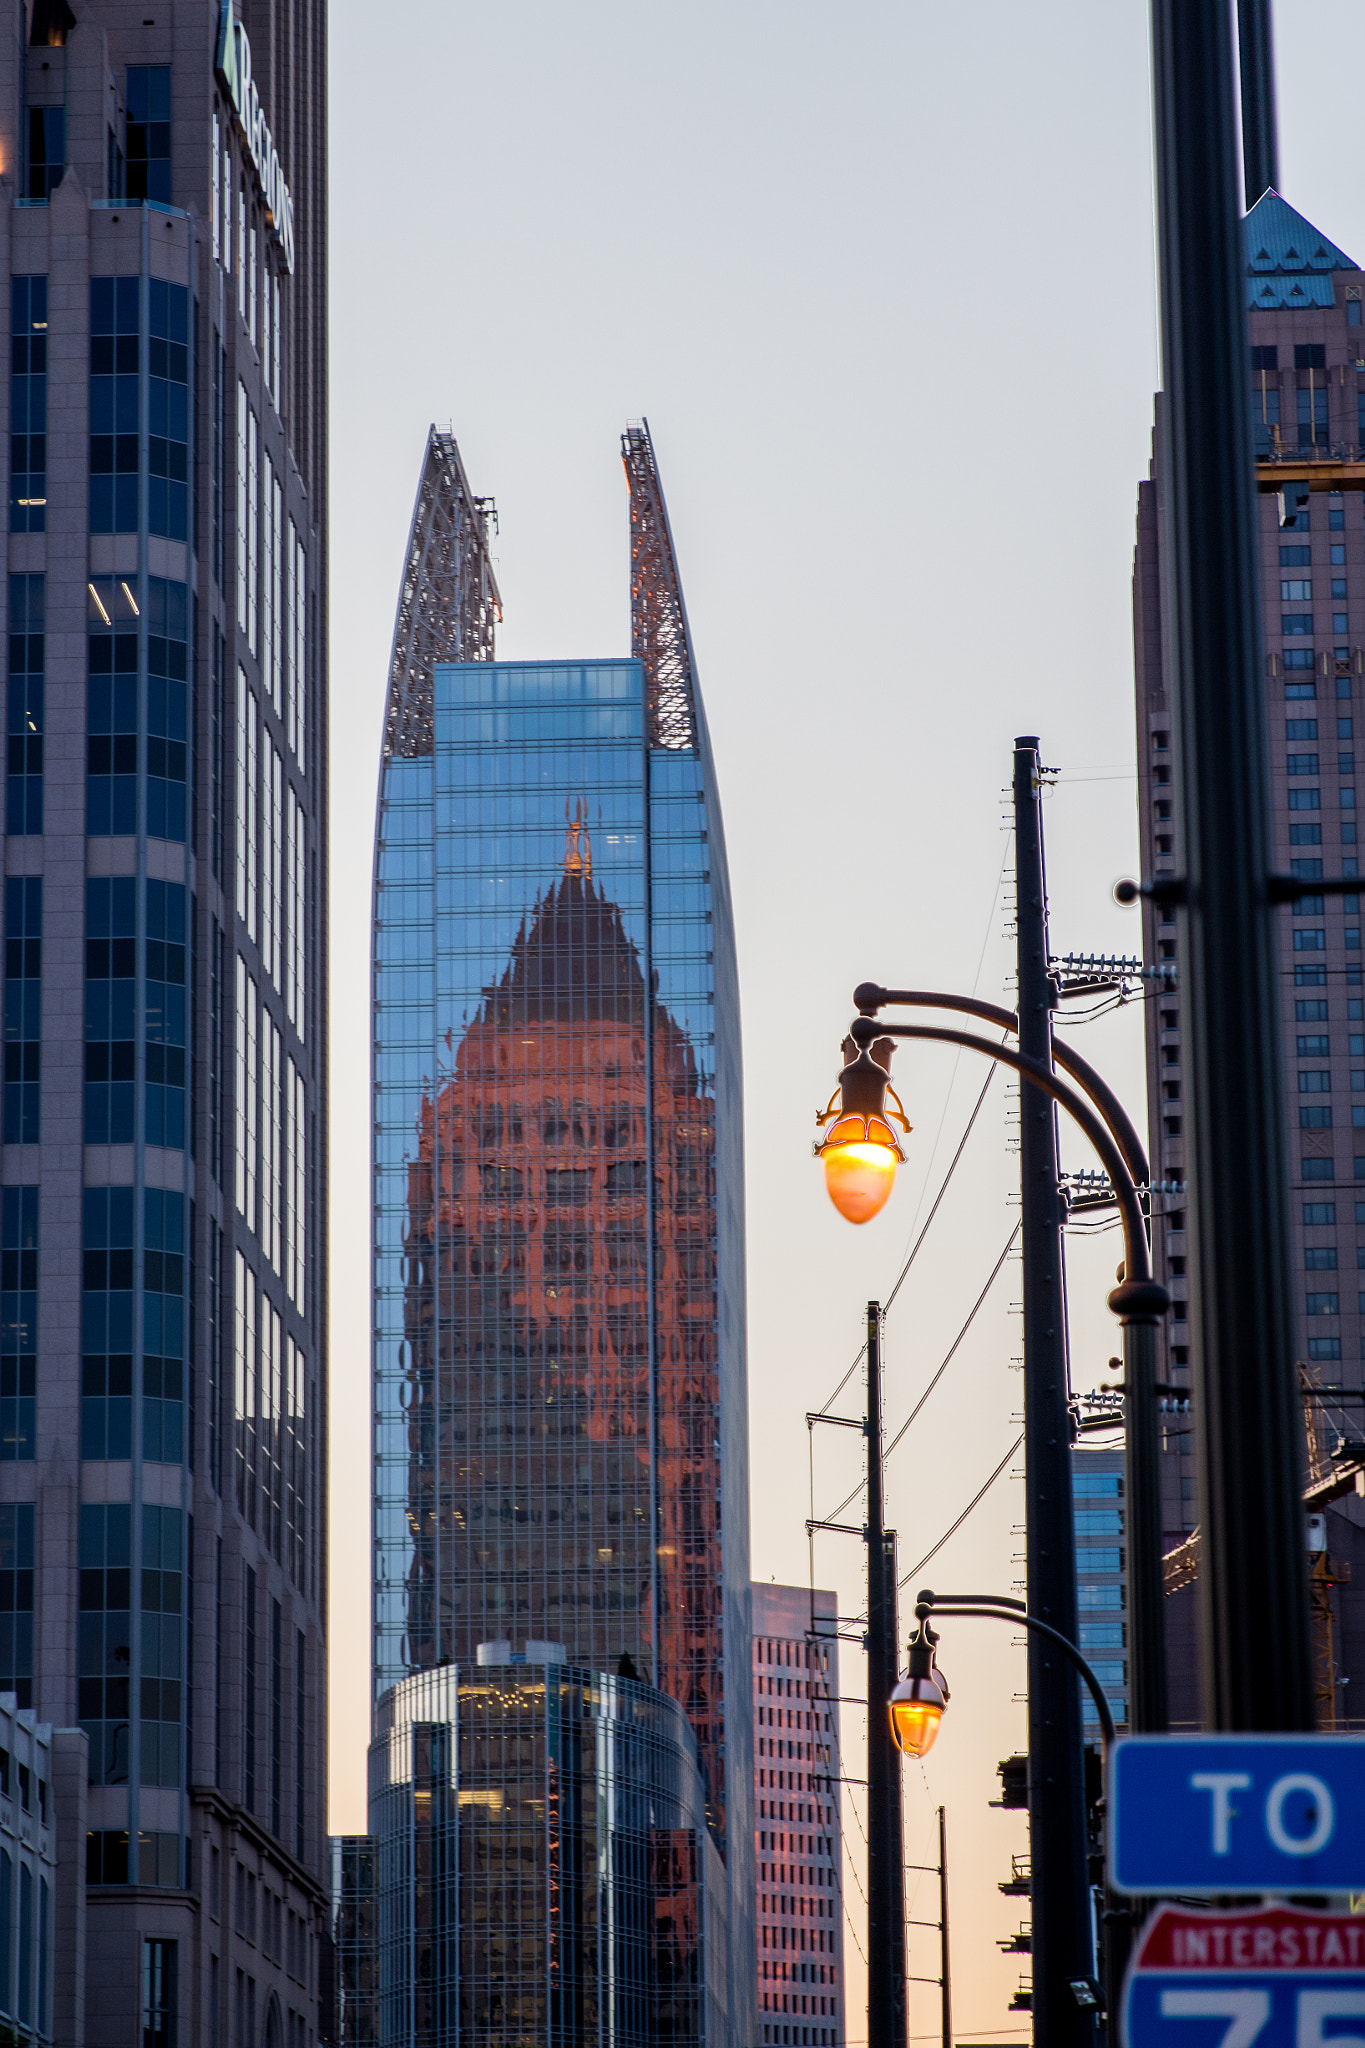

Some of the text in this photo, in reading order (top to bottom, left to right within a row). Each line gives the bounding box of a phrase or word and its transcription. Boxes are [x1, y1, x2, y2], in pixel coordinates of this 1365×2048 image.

[233, 20, 295, 275] REGIONS
[1190, 1773, 1335, 1854] TO
[1172, 1926, 1365, 1964] INTERSTAT
